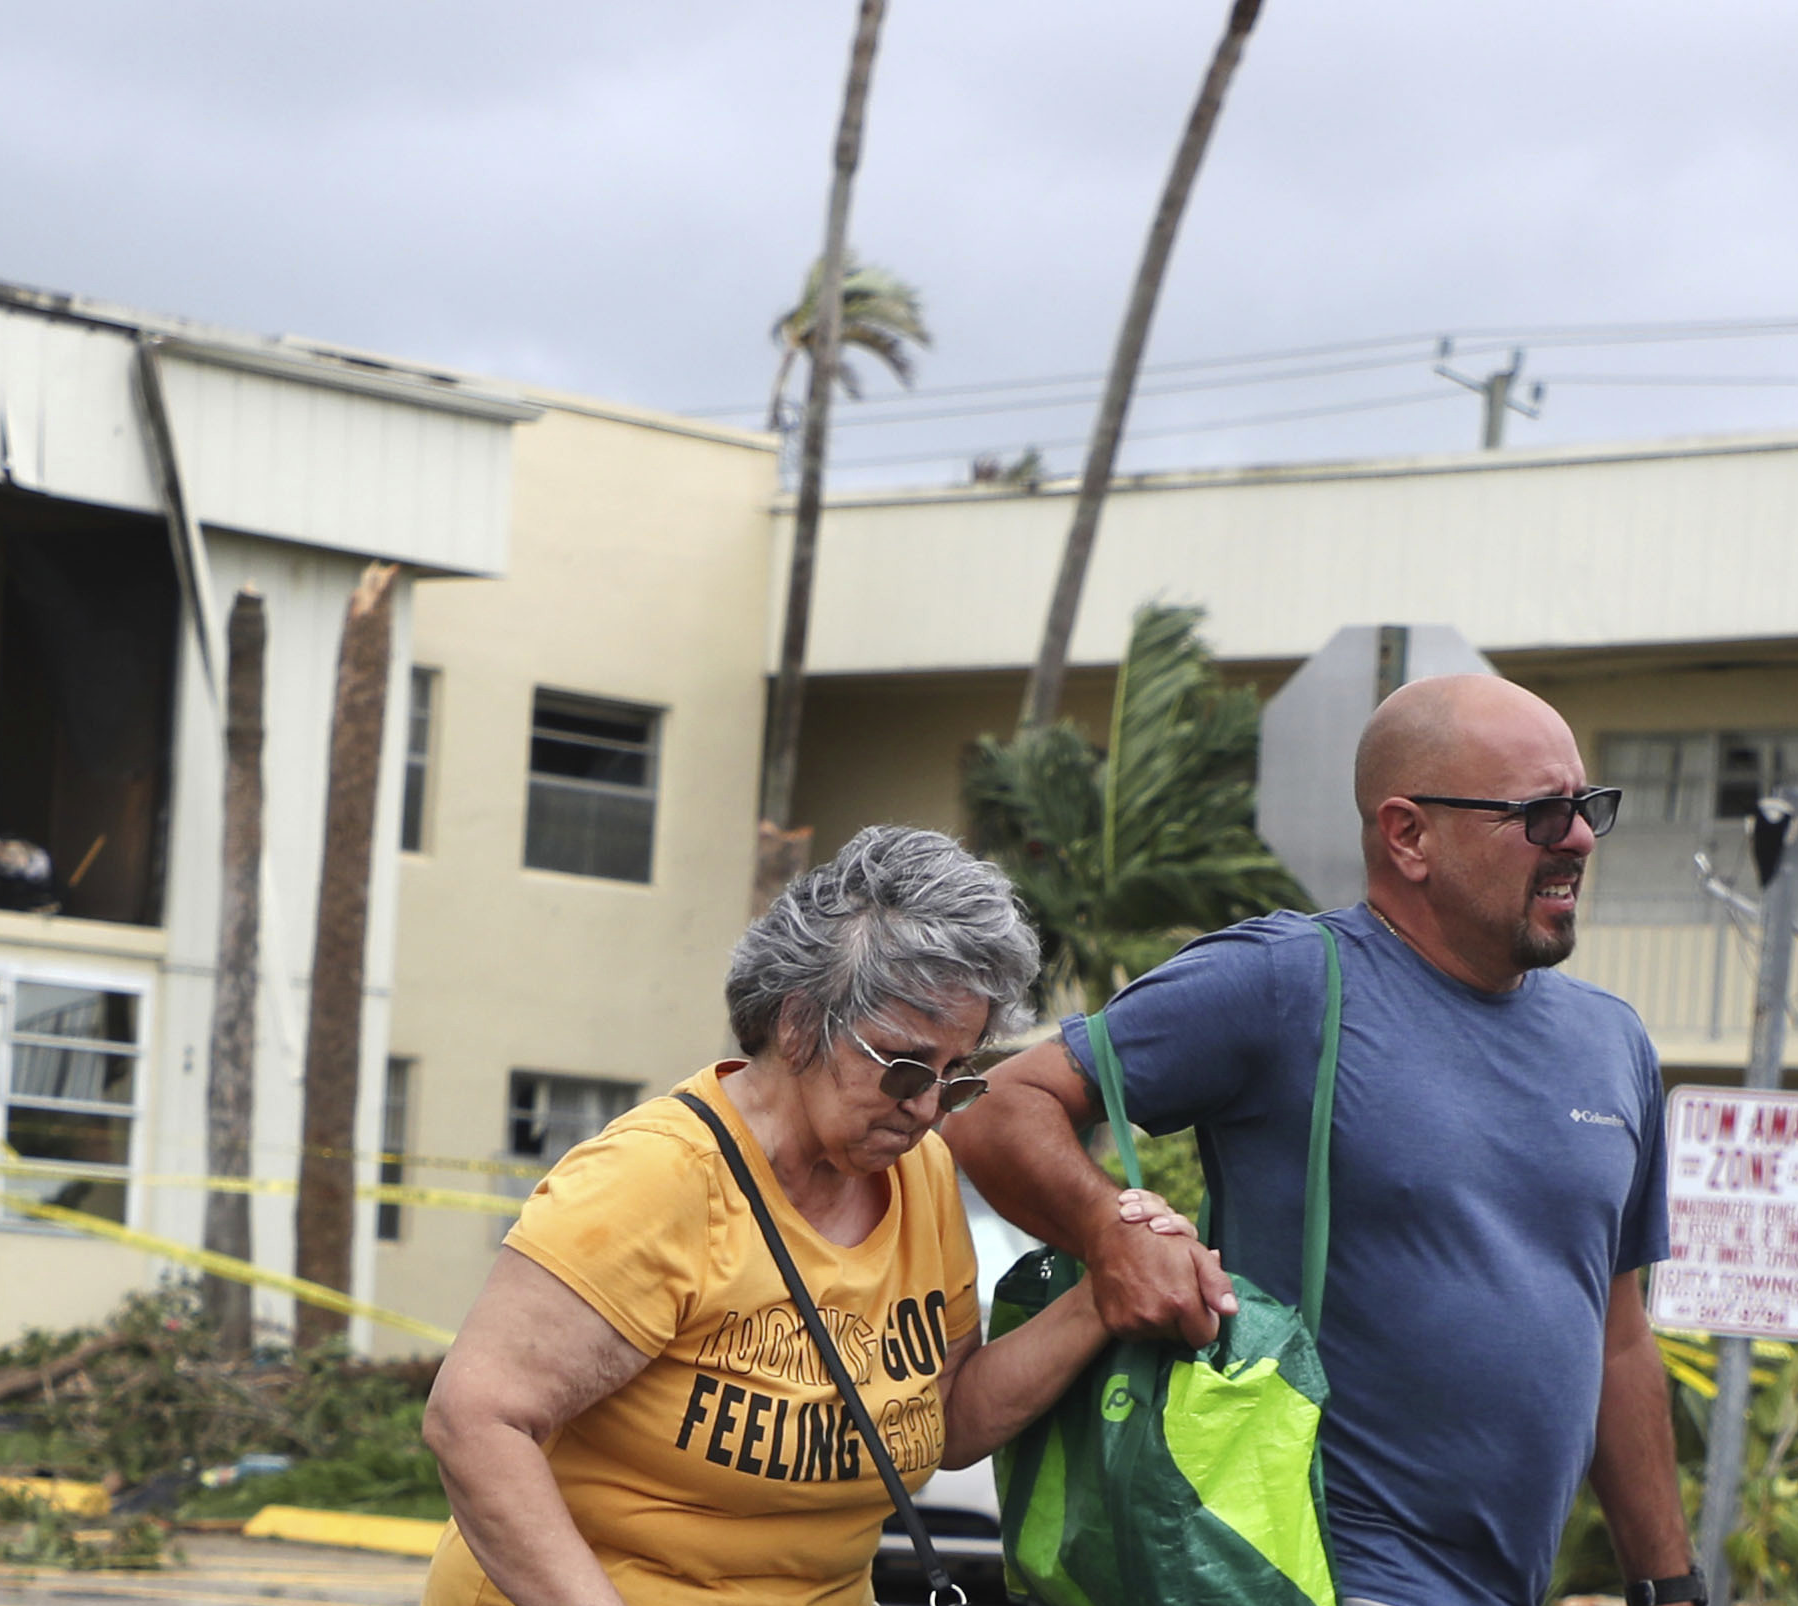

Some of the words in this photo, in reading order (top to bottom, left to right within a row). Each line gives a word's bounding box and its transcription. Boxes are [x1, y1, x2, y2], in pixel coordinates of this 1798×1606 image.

[1683, 1100, 1740, 1143] TOW
[1707, 1147, 1783, 1194] ZONE
[694, 1307, 878, 1386] LOOKING
[676, 1373, 860, 1482] FEELING
